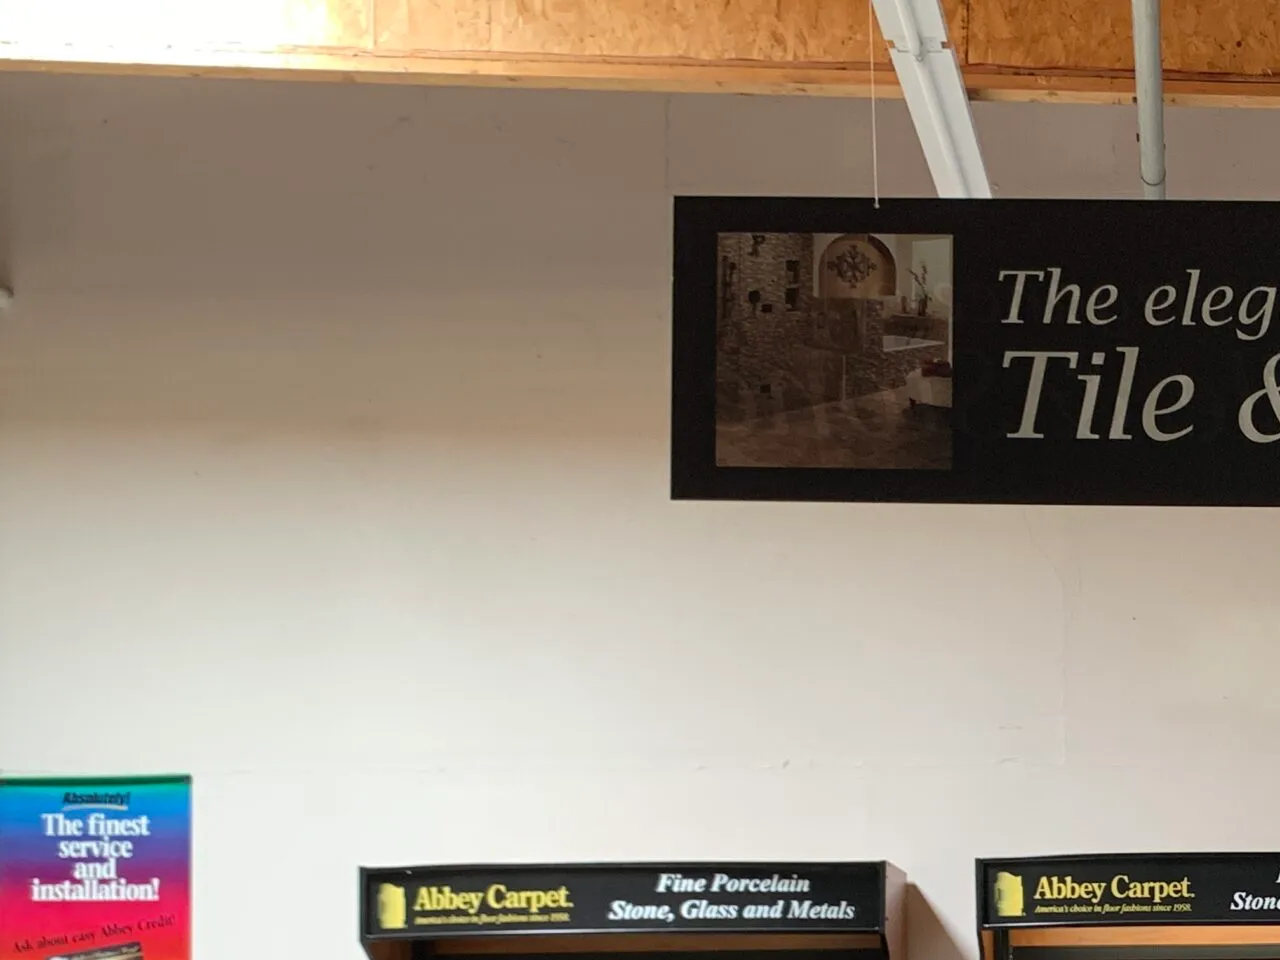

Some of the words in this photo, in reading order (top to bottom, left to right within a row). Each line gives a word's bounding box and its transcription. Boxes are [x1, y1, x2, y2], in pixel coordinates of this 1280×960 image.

[998, 269, 1118, 327] The
[1000, 346, 1197, 441] Tile
[41, 813, 84, 837] The
[87, 812, 150, 837] finest
[58, 836, 133, 859] service
[73, 858, 118, 880] and
[31, 877, 160, 902] installation!
[655, 873, 708, 893] Fine
[711, 873, 811, 893] Porcelain
[1033, 875, 1106, 904] Abbey
[413, 885, 484, 914] Abbey
[607, 901, 675, 923] Stone,
[680, 900, 739, 920] Glass
[743, 900, 783, 920] and
[787, 899, 856, 920] Metals
[1034, 905, 1069, 914] America's
[1069, 904, 1092, 913] choice
[1094, 904, 1102, 912] in
[1102, 904, 1120, 915] floor
[1120, 904, 1152, 915] fashions
[1152, 904, 1173, 912] since
[13, 939, 34, 953] Ask
[37, 935, 69, 949] about
[101, 923, 133, 939] Abbey
